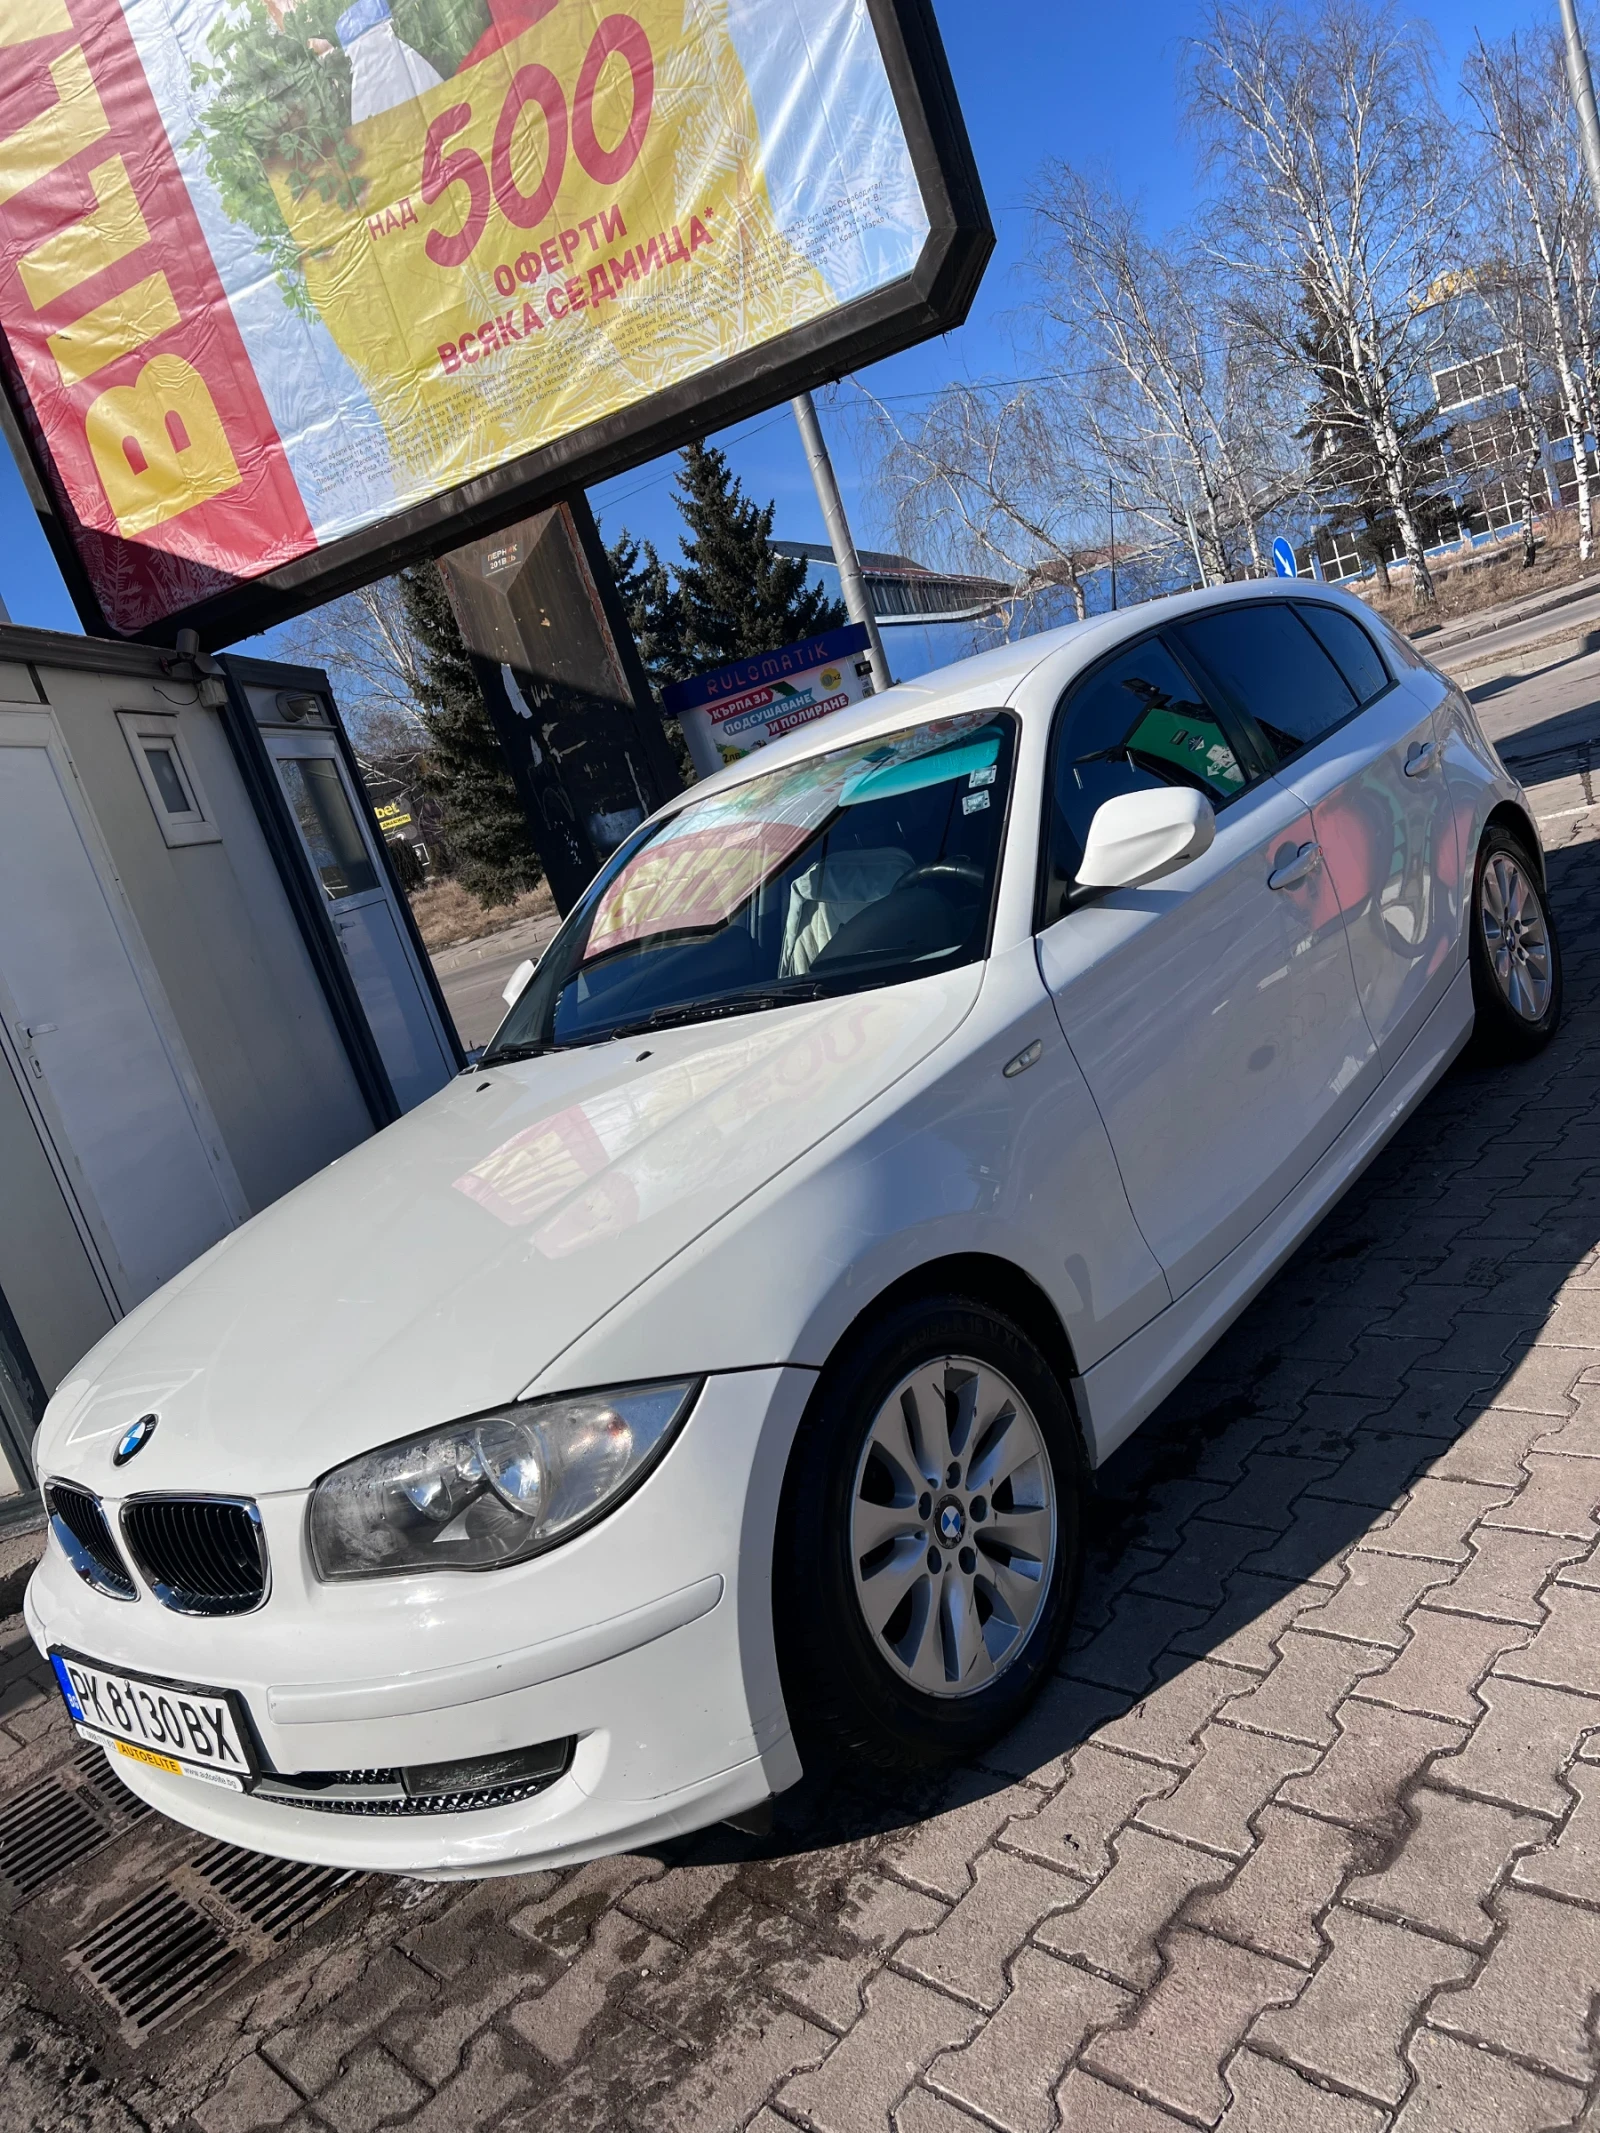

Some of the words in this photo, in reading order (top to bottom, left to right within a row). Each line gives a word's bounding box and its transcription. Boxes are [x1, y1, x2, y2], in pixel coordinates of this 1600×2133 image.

[367, 197, 419, 241] НАД
[421, 13, 654, 268] 500
[0, 0, 242, 538] BILL
[493, 203, 628, 297] ОФЕРТИ
[437, 302, 545, 375] ВСЯКА
[712, 698, 753, 719] КЪРПА
[755, 692, 769, 704] ЗА
[725, 694, 812, 734] ПОДСУШАВАНЕ
[769, 721, 779, 733] И
[780, 695, 847, 728] ПОЛИРАНЕ
[121, 1744, 179, 1772] AUTOELITE
